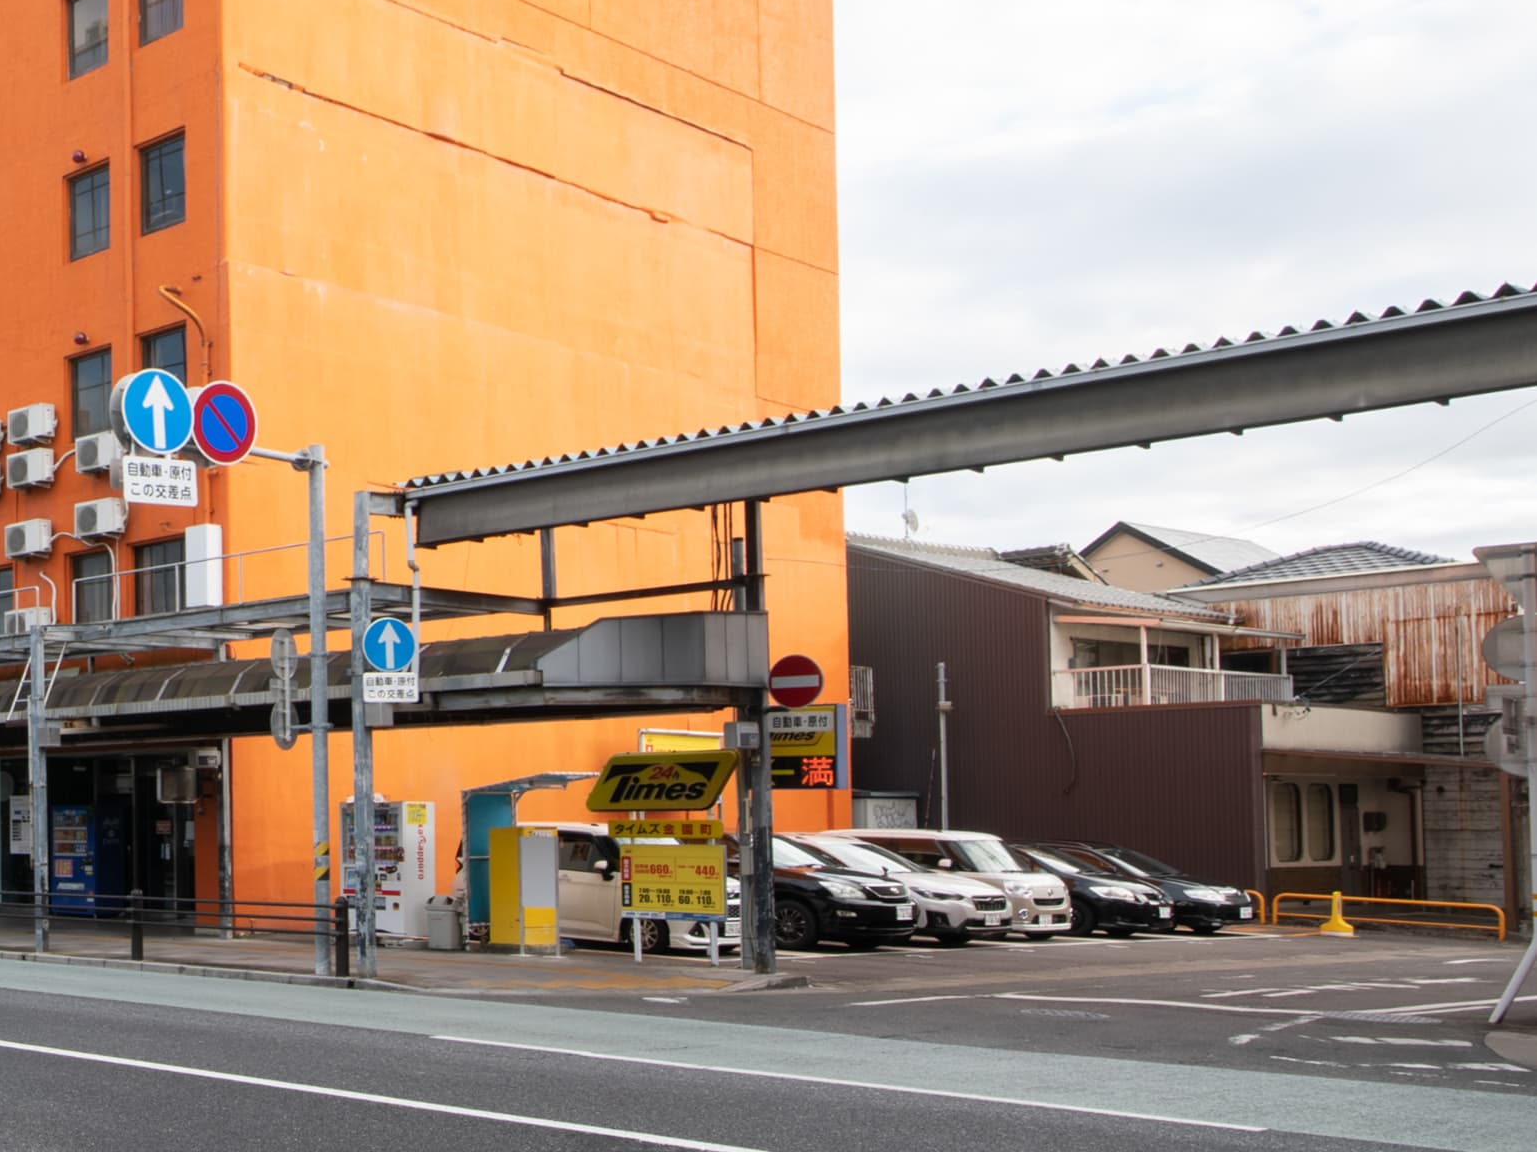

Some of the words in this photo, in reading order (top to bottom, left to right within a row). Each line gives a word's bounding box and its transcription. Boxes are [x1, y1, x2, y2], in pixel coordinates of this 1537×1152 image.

[128, 462, 191, 481] 自動車・原付
[130, 482, 192, 500] この交差点
[801, 757, 834, 786] 満
[607, 768, 709, 803] Times
